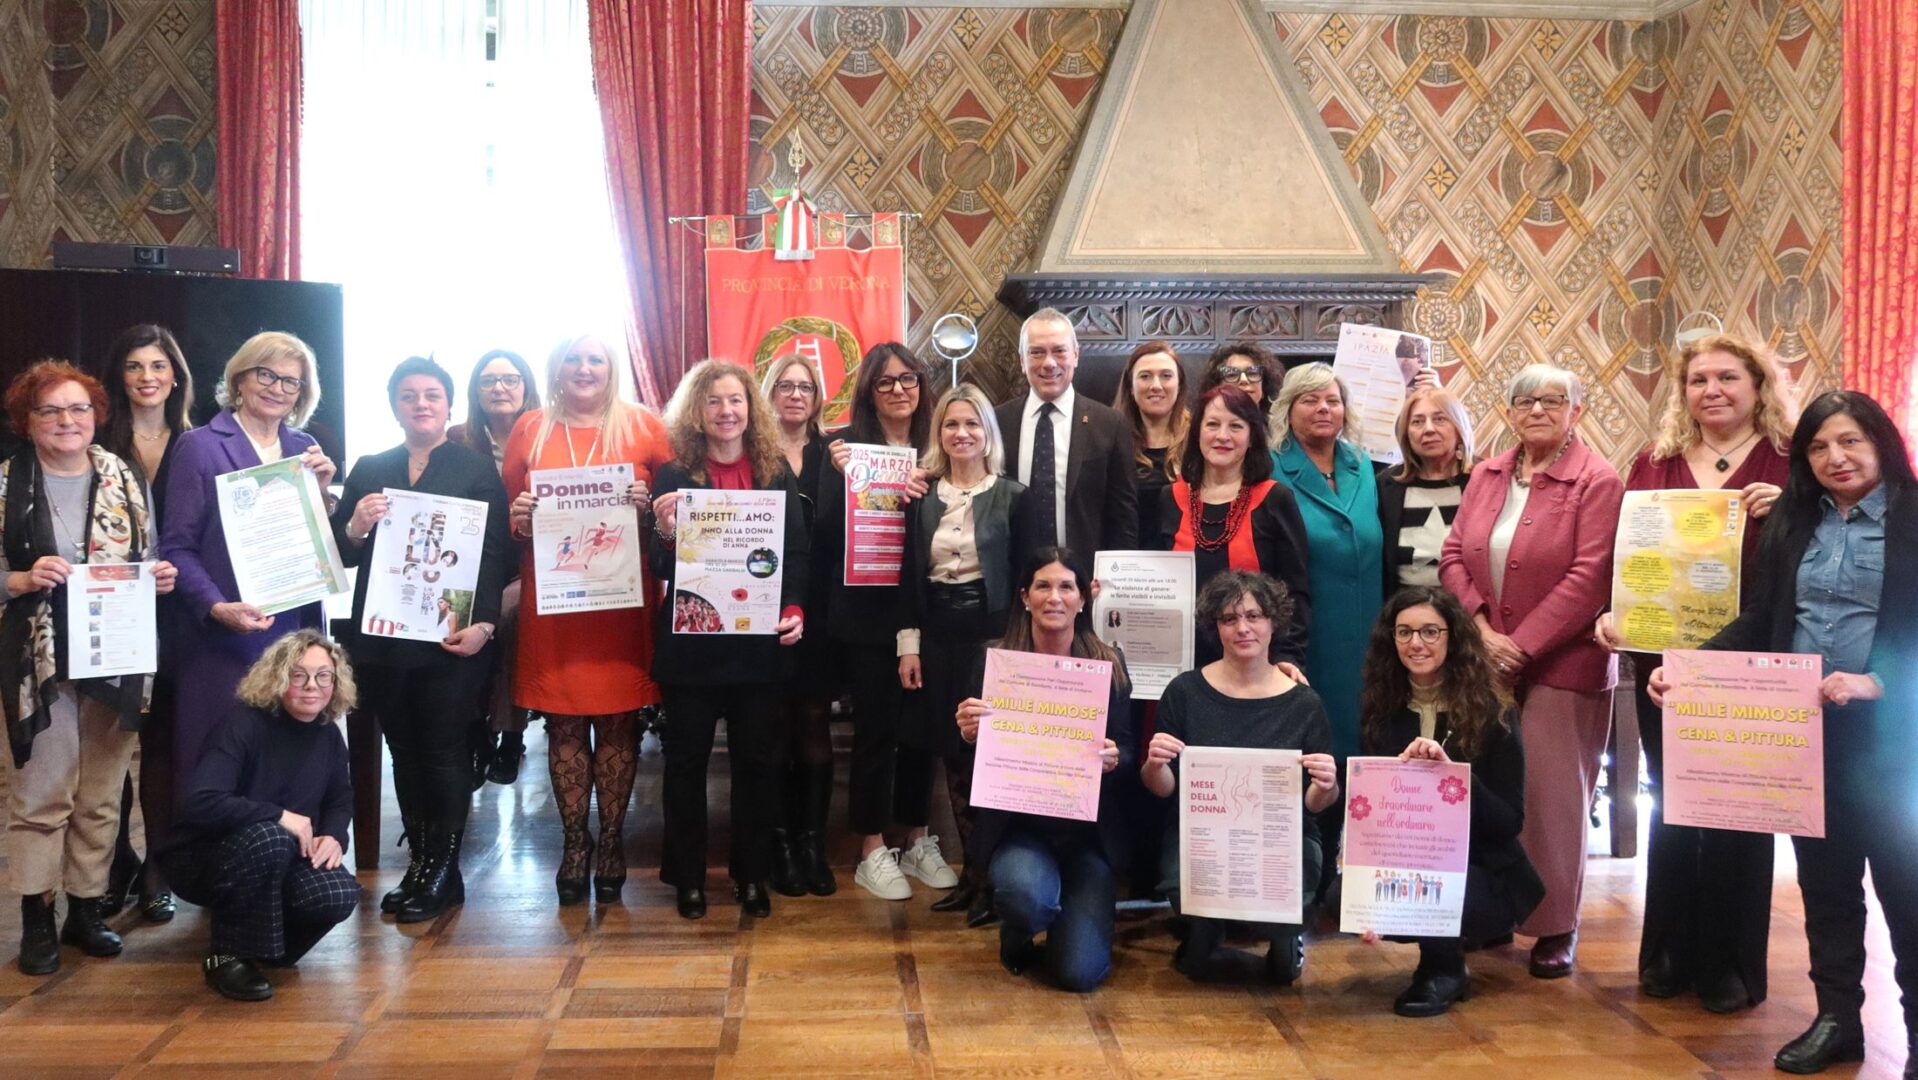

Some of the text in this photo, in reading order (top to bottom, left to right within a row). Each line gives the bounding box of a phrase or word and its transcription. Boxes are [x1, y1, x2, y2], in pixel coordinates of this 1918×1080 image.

[722, 275, 890, 293] PROVINCIA DI VERONA
[870, 457, 913, 473] MARZO
[850, 462, 911, 493] Donna
[536, 481, 613, 498] Donne
[557, 493, 630, 510] in marcia
[690, 512, 775, 522] RISPETTI...AMO:
[1667, 702, 1820, 723] "MILLE MIMOSE"
[991, 719, 1094, 741] CENA & PITTURA
[1677, 727, 1809, 748] CENA & PITTURA
[1190, 780, 1215, 789] MESE
[1390, 775, 1422, 793] Donne
[1190, 793, 1217, 801] DELLA
[1190, 805, 1227, 814] DONNA
